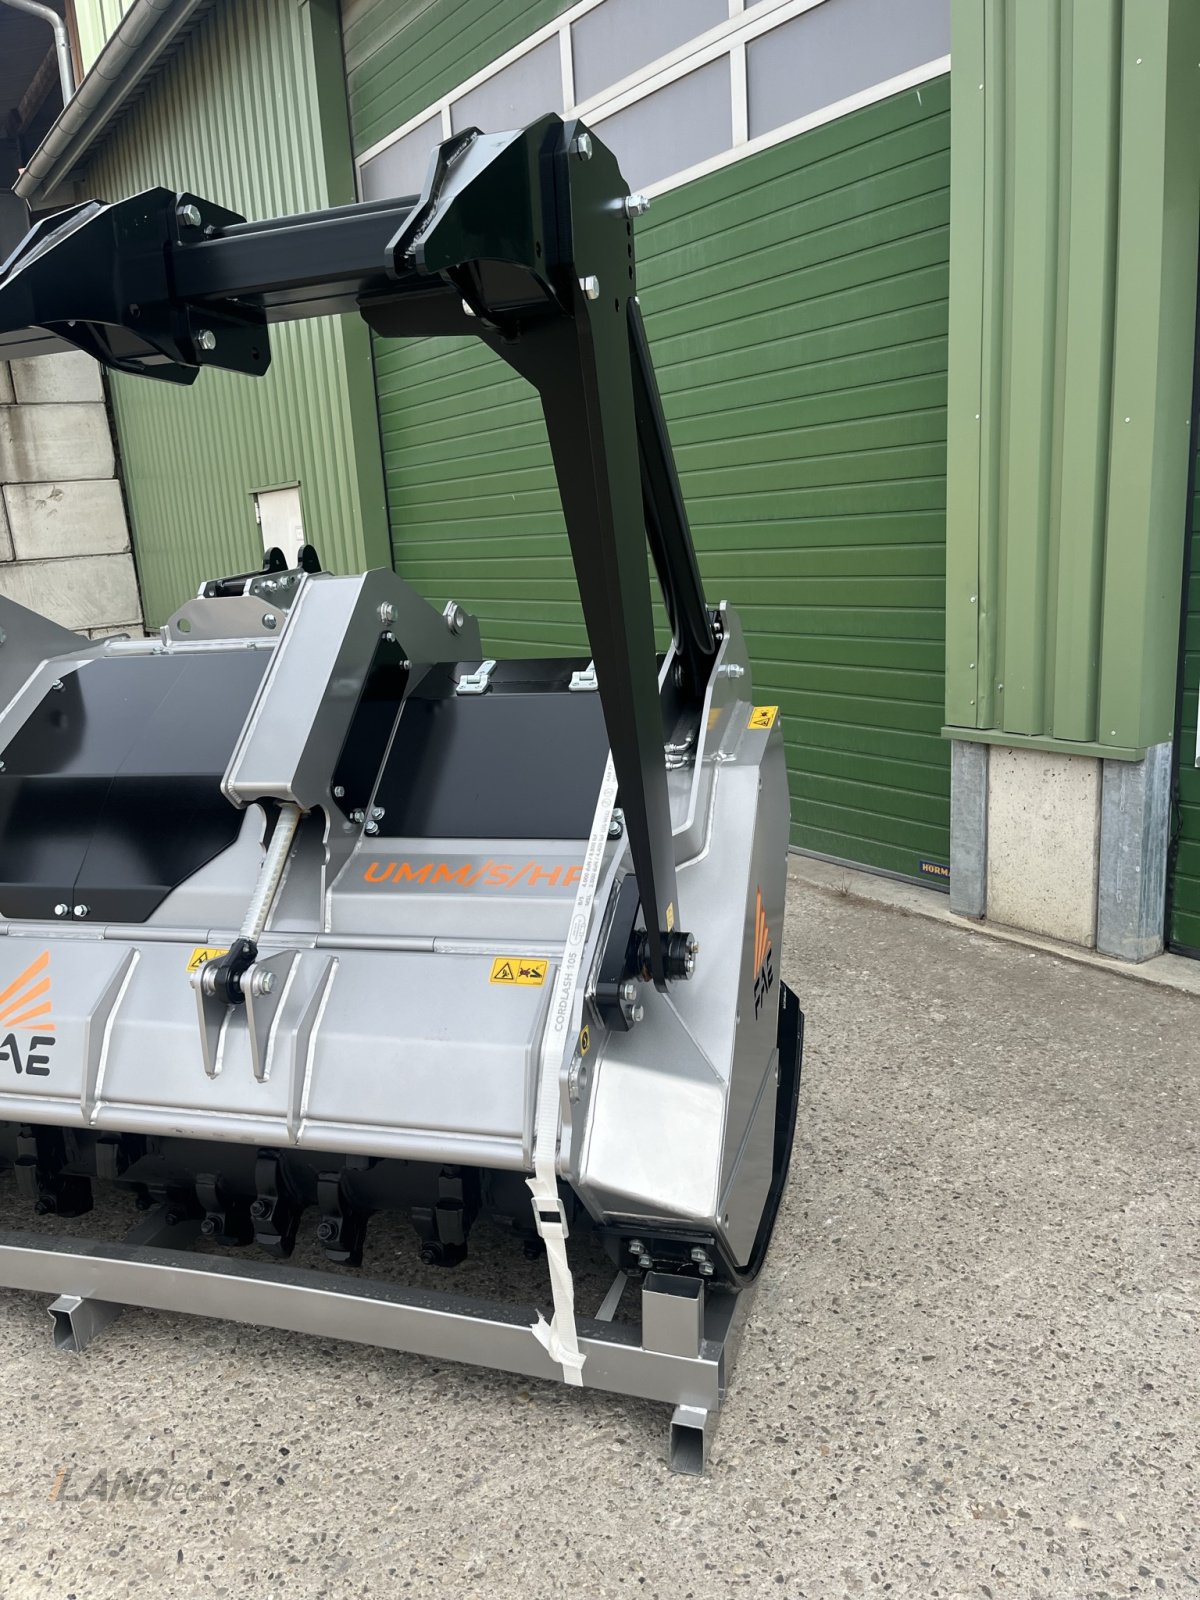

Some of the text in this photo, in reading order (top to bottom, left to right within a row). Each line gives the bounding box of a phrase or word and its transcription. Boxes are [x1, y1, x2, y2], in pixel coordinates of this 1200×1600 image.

[554, 973, 574, 1032] CORDLASH
[567, 952, 577, 970] 105
[754, 948, 774, 1021] FAE
[0, 1033, 56, 1077] AE
